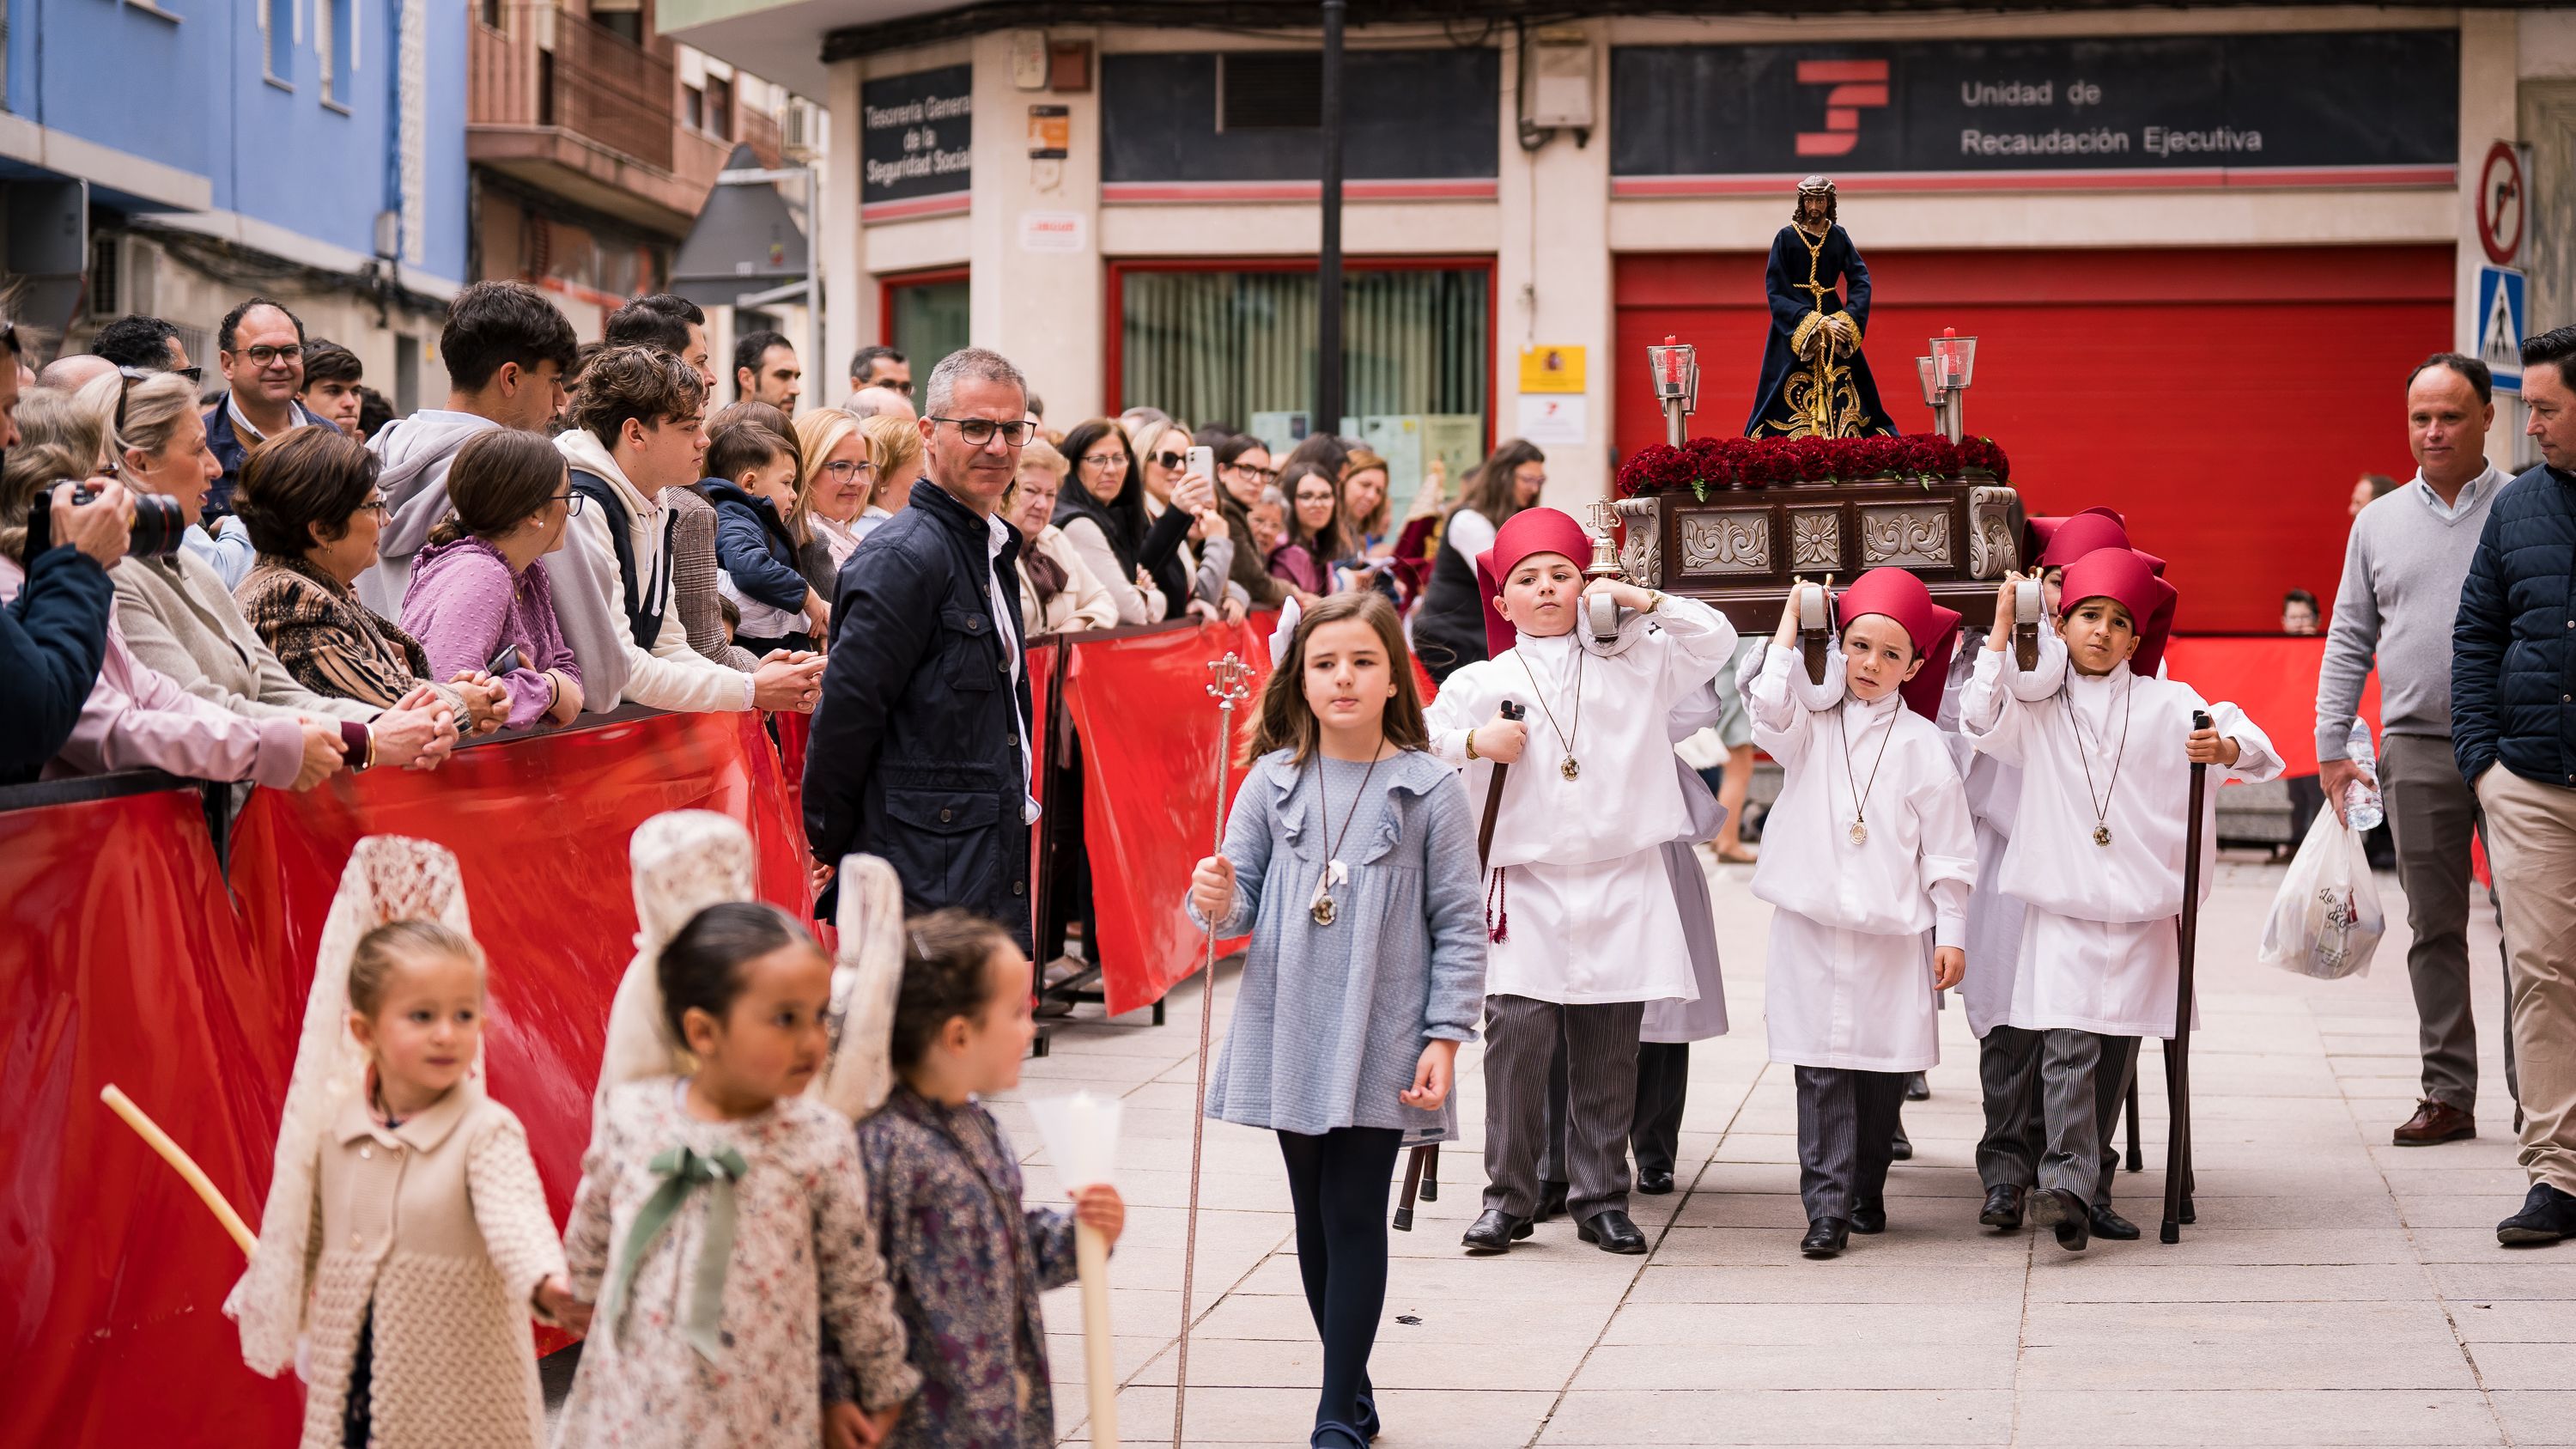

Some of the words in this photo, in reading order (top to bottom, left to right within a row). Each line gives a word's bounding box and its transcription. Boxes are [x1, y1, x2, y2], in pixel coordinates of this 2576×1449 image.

[926, 95, 971, 119] Genera
[1961, 79, 2053, 107] Unidad
[2067, 79, 2102, 105] de
[902, 128, 921, 153] de
[922, 125, 937, 149] la
[1961, 127, 2129, 155] Recaudación
[2143, 125, 2263, 158] Ejecutiva
[866, 152, 932, 188] Seguridad
